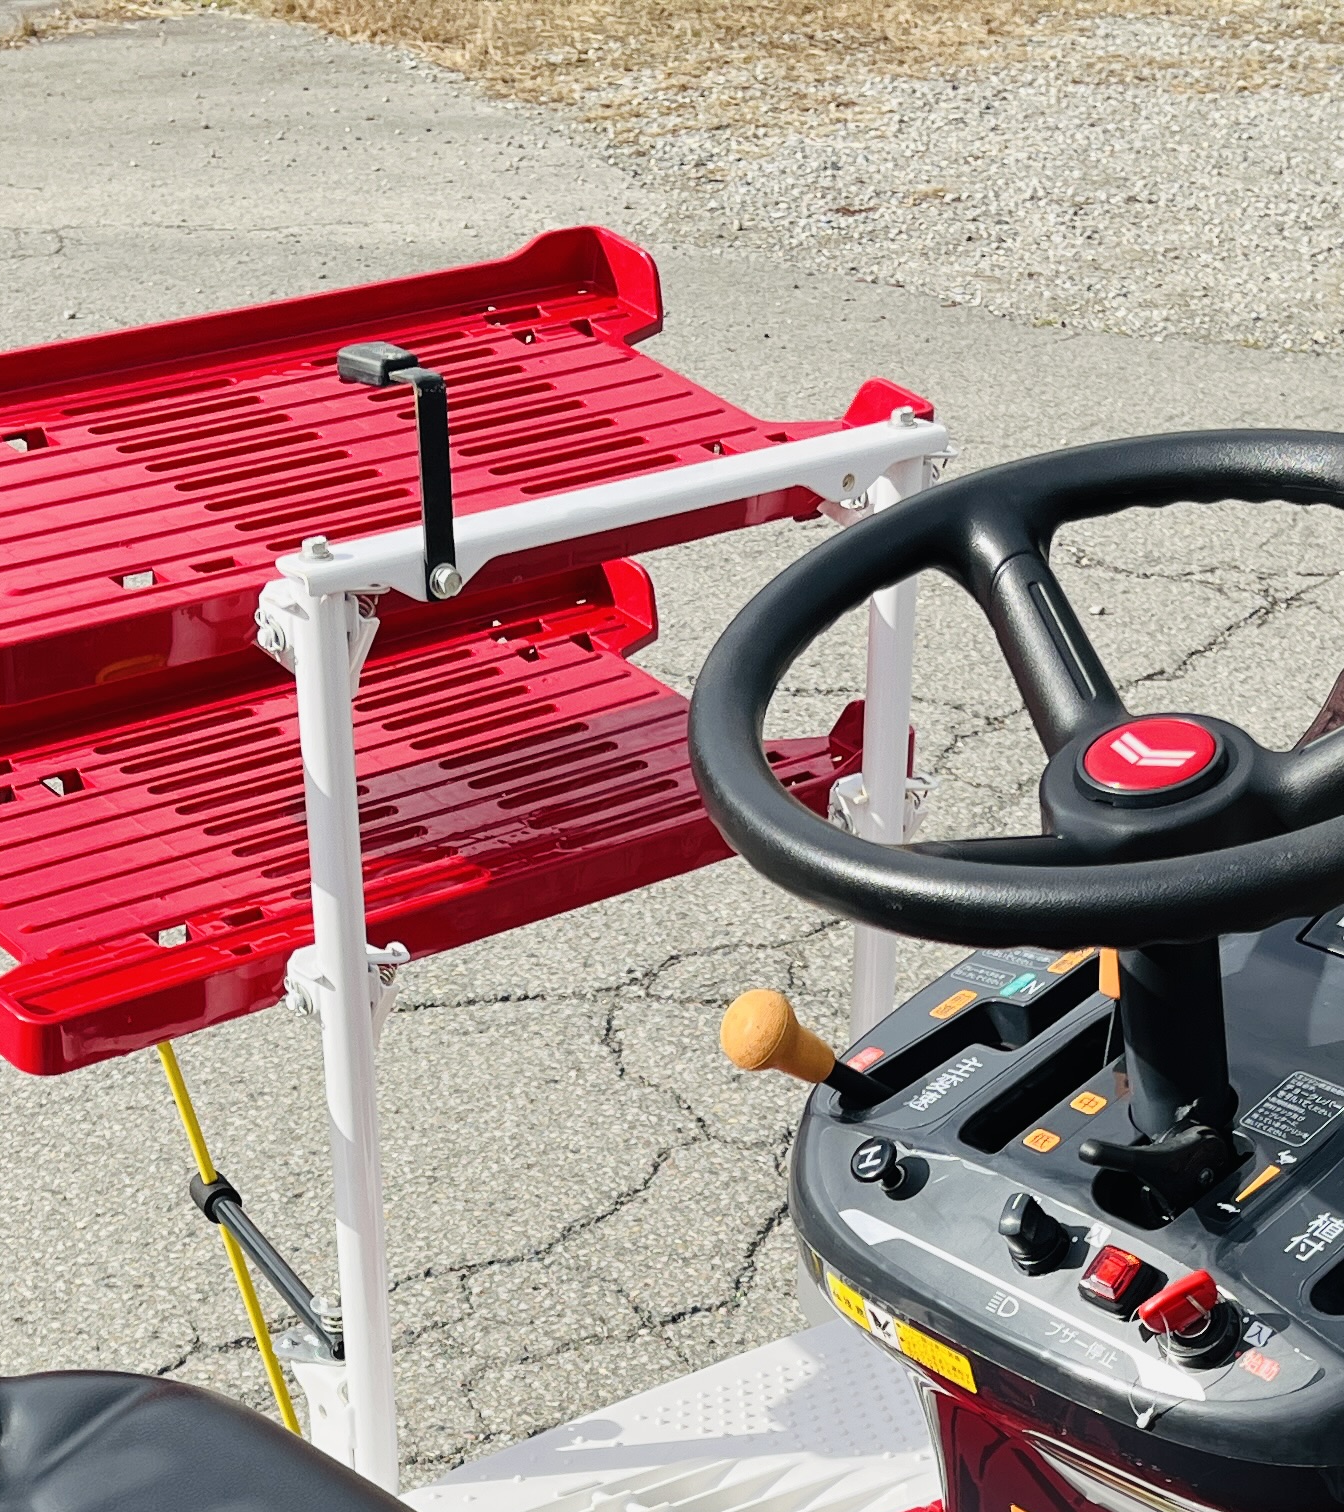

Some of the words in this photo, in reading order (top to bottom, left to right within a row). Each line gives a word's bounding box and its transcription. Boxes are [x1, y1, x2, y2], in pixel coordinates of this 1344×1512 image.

[905, 1056, 984, 1113] 主変速
[1079, 1094, 1099, 1110] 中
[1031, 1132, 1054, 1149] 低
[1088, 1227, 1105, 1245] 入
[1044, 1320, 1121, 1370] ブザー停止
[1246, 1324, 1264, 1345] 入
[1239, 1348, 1282, 1382] 始動
